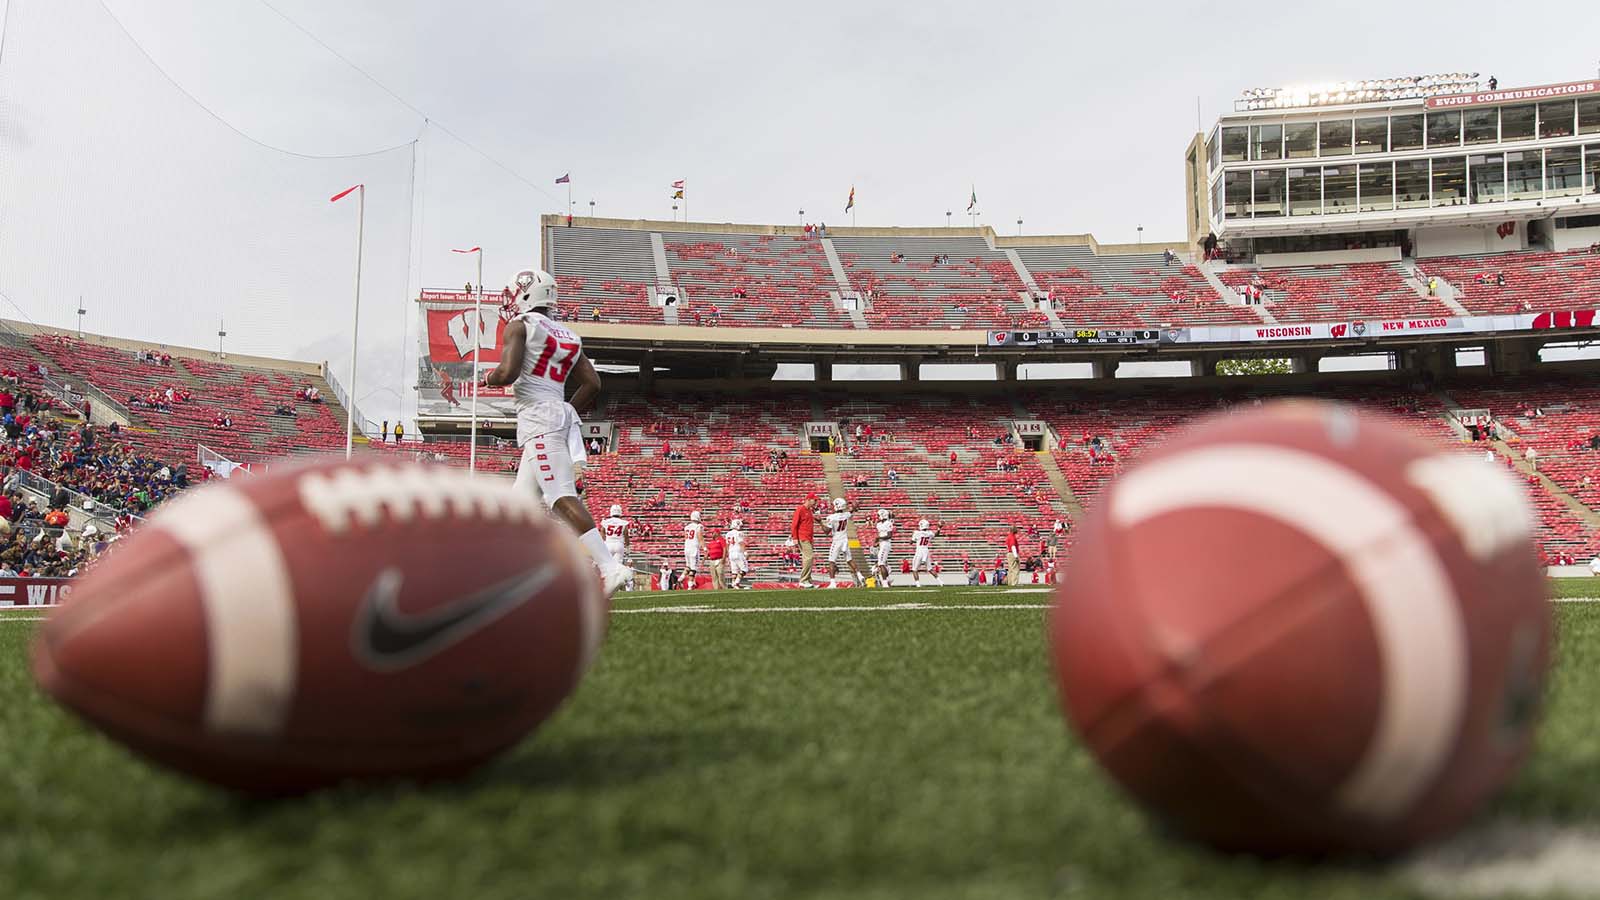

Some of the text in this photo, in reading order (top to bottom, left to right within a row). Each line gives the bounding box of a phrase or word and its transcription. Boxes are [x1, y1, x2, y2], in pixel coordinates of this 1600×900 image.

[1435, 83, 1595, 107] EVJUE COMMUNICATIONS
[1382, 318, 1447, 331] NEW MEXICO
[1022, 332, 1030, 341] 0
[1076, 330, 1097, 338] 58:57
[1143, 331, 1150, 339] 0
[1256, 326, 1312, 338] WISCONSIN
[531, 334, 581, 384] 13
[606, 525, 623, 537] 54
[919, 536, 930, 546] 16
